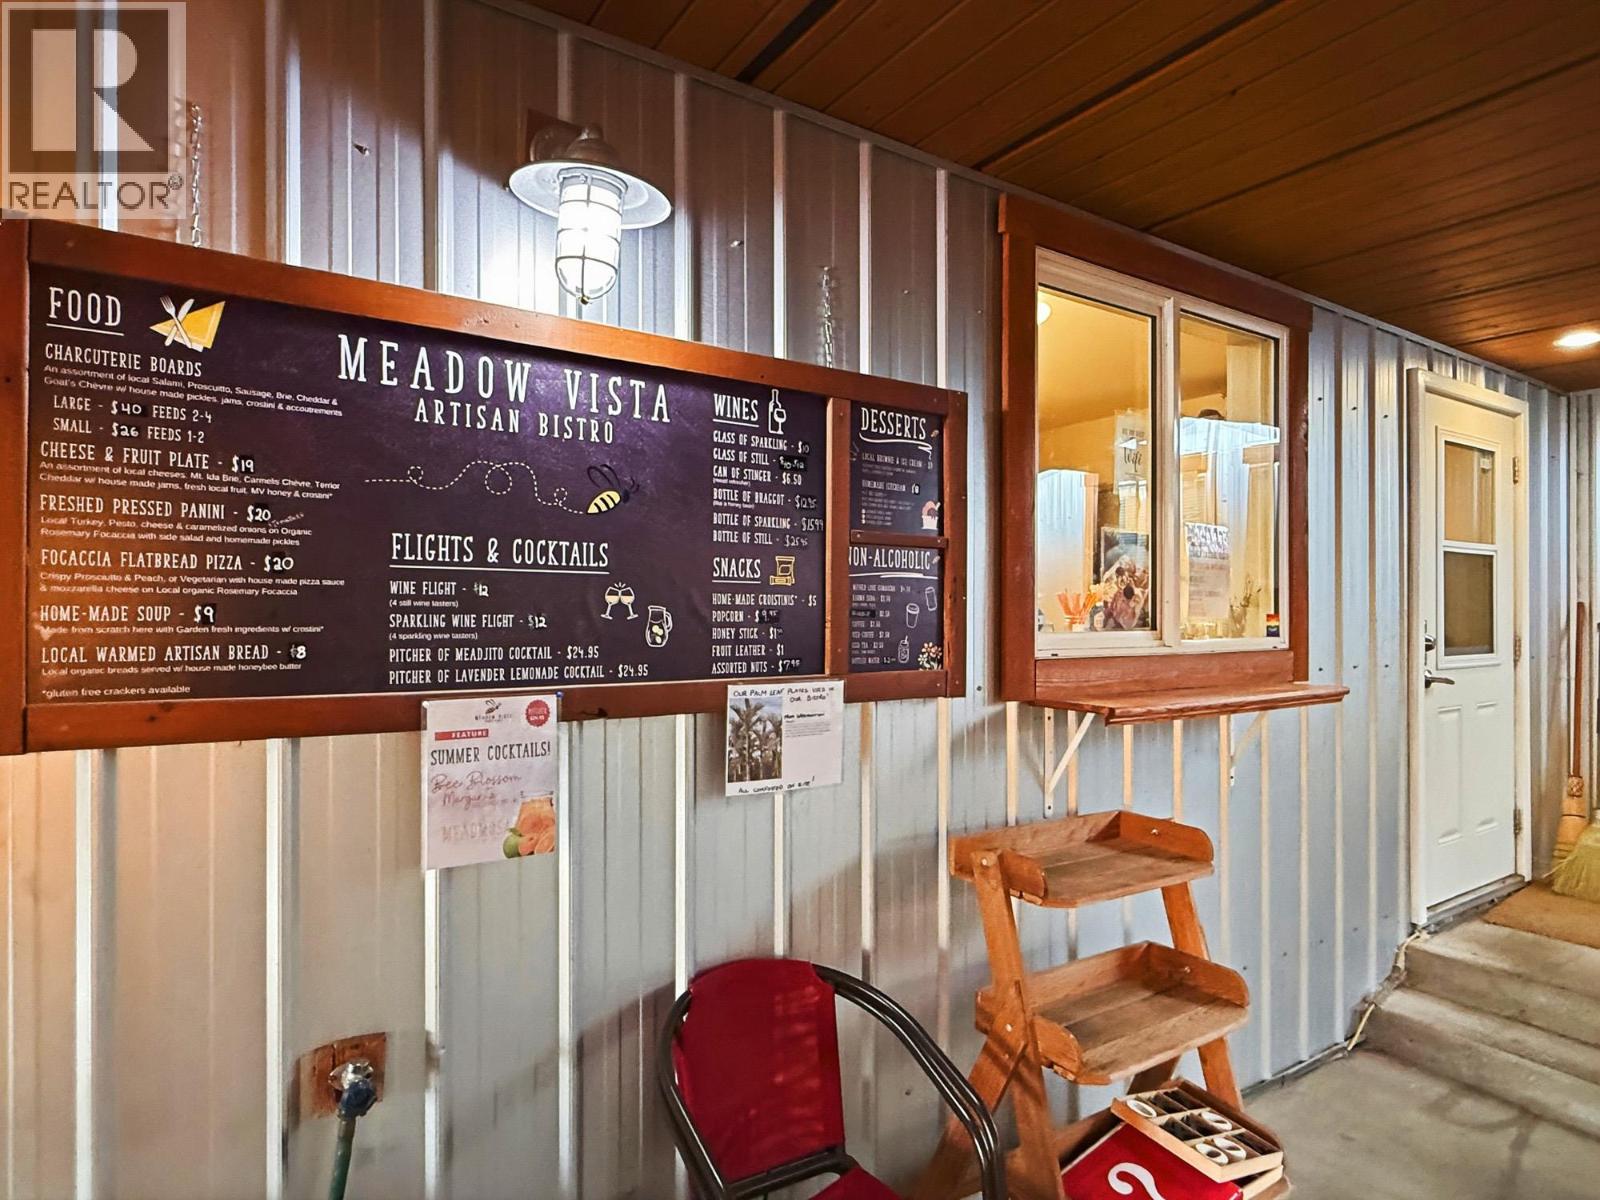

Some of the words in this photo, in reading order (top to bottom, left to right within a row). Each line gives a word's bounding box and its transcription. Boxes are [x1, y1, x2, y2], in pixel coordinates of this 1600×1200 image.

[49, 287, 121, 326] FOOD
[45, 343, 141, 370] CHARCUTERIE
[150, 356, 202, 377] BOARDS
[338, 334, 531, 403] MEADOW
[564, 368, 670, 423] VISTA
[53, 395, 91, 411] LARGE
[111, 400, 142, 415] $40
[152, 404, 186, 421] FEEDS
[192, 409, 212, 424] 2-4
[714, 393, 758, 422] WINES
[53, 418, 92, 434] SMALL
[112, 422, 139, 437] $26
[147, 426, 182, 442] FEEDS
[187, 430, 205, 444] 1-2
[414, 398, 520, 434] ARTISAN
[538, 413, 614, 444] BISTRO
[861, 407, 926, 440] DESSERTS
[713, 430, 736, 444] GLASS
[738, 434, 748, 446] OF
[750, 436, 788, 451] SPARKLING
[41, 441, 96, 461] CHEESE
[104, 446, 114, 462] &
[122, 448, 162, 466] FRUIT
[169, 451, 210, 470] PLATE
[232, 455, 254, 473] $19
[713, 448, 736, 462] GLASS
[738, 451, 748, 463] OF
[750, 452, 770, 466] STILL
[713, 466, 728, 478] CAN
[732, 467, 740, 480] OF
[744, 468, 772, 482] STINGER
[782, 472, 802, 486] $6.50
[713, 488, 739, 502] BOTTLE
[742, 490, 752, 503] OF
[754, 492, 785, 506] BRAGGOT
[40, 494, 104, 514] FRESHED
[113, 498, 172, 517] PRESSED
[181, 502, 225, 520] PANINI
[246, 505, 272, 522] $20
[713, 512, 739, 526] BOTTLE
[742, 514, 752, 527] OF
[754, 516, 791, 530] SPARKLING
[713, 530, 739, 543] BOTTLE
[742, 532, 751, 544] OF
[754, 532, 773, 545] STILL
[391, 532, 474, 563] FLIGHTS
[487, 538, 500, 563] &
[512, 538, 609, 567] COCKTAILS
[41, 548, 112, 567] FOCACCIA
[120, 551, 198, 570] FLATBREAD
[206, 554, 243, 571] PIZZA
[264, 554, 294, 572] $20
[713, 556, 761, 578] SNACKS
[389, 580, 417, 595] WINE
[422, 581, 457, 596] FLIGHT
[712, 592, 755, 606] HOME-MADE
[808, 594, 817, 606] $5
[40, 605, 129, 622] HOME-MADE
[137, 606, 172, 622] SOUP
[194, 605, 214, 624] $9
[389, 614, 446, 628] SPARKLING
[452, 614, 477, 628] WINE
[482, 614, 514, 628] FLIGHT
[528, 614, 548, 629] $12
[712, 610, 744, 623] POPCORN
[712, 628, 736, 640] HONEY
[738, 628, 758, 640] STICK
[42, 647, 88, 664] LOCAL
[96, 646, 156, 662] WARMED
[164, 645, 220, 662] ARTISAN
[228, 645, 269, 661] BREAD
[389, 648, 432, 663] PITCHER
[438, 648, 450, 662] OF
[455, 647, 504, 661] MEADJITO
[509, 646, 552, 660] COCKTAIL
[566, 646, 599, 660] $24.95
[712, 645, 732, 657] FRUIT
[736, 644, 766, 656] LEATHER
[776, 644, 784, 656] $1
[389, 669, 432, 685] PITCHER
[438, 669, 450, 684] OF
[455, 668, 506, 683] LAVENDER
[510, 666, 559, 681] LEMONADE
[564, 665, 604, 679] COCKTAIL
[618, 664, 649, 678] $24.95
[712, 662, 748, 674] ASSORTED
[750, 661, 768, 673] NUTS
[451, 730, 488, 738] FEATURE
[430, 746, 480, 766] SUMMER
[488, 740, 552, 761] COCKTAILS!
